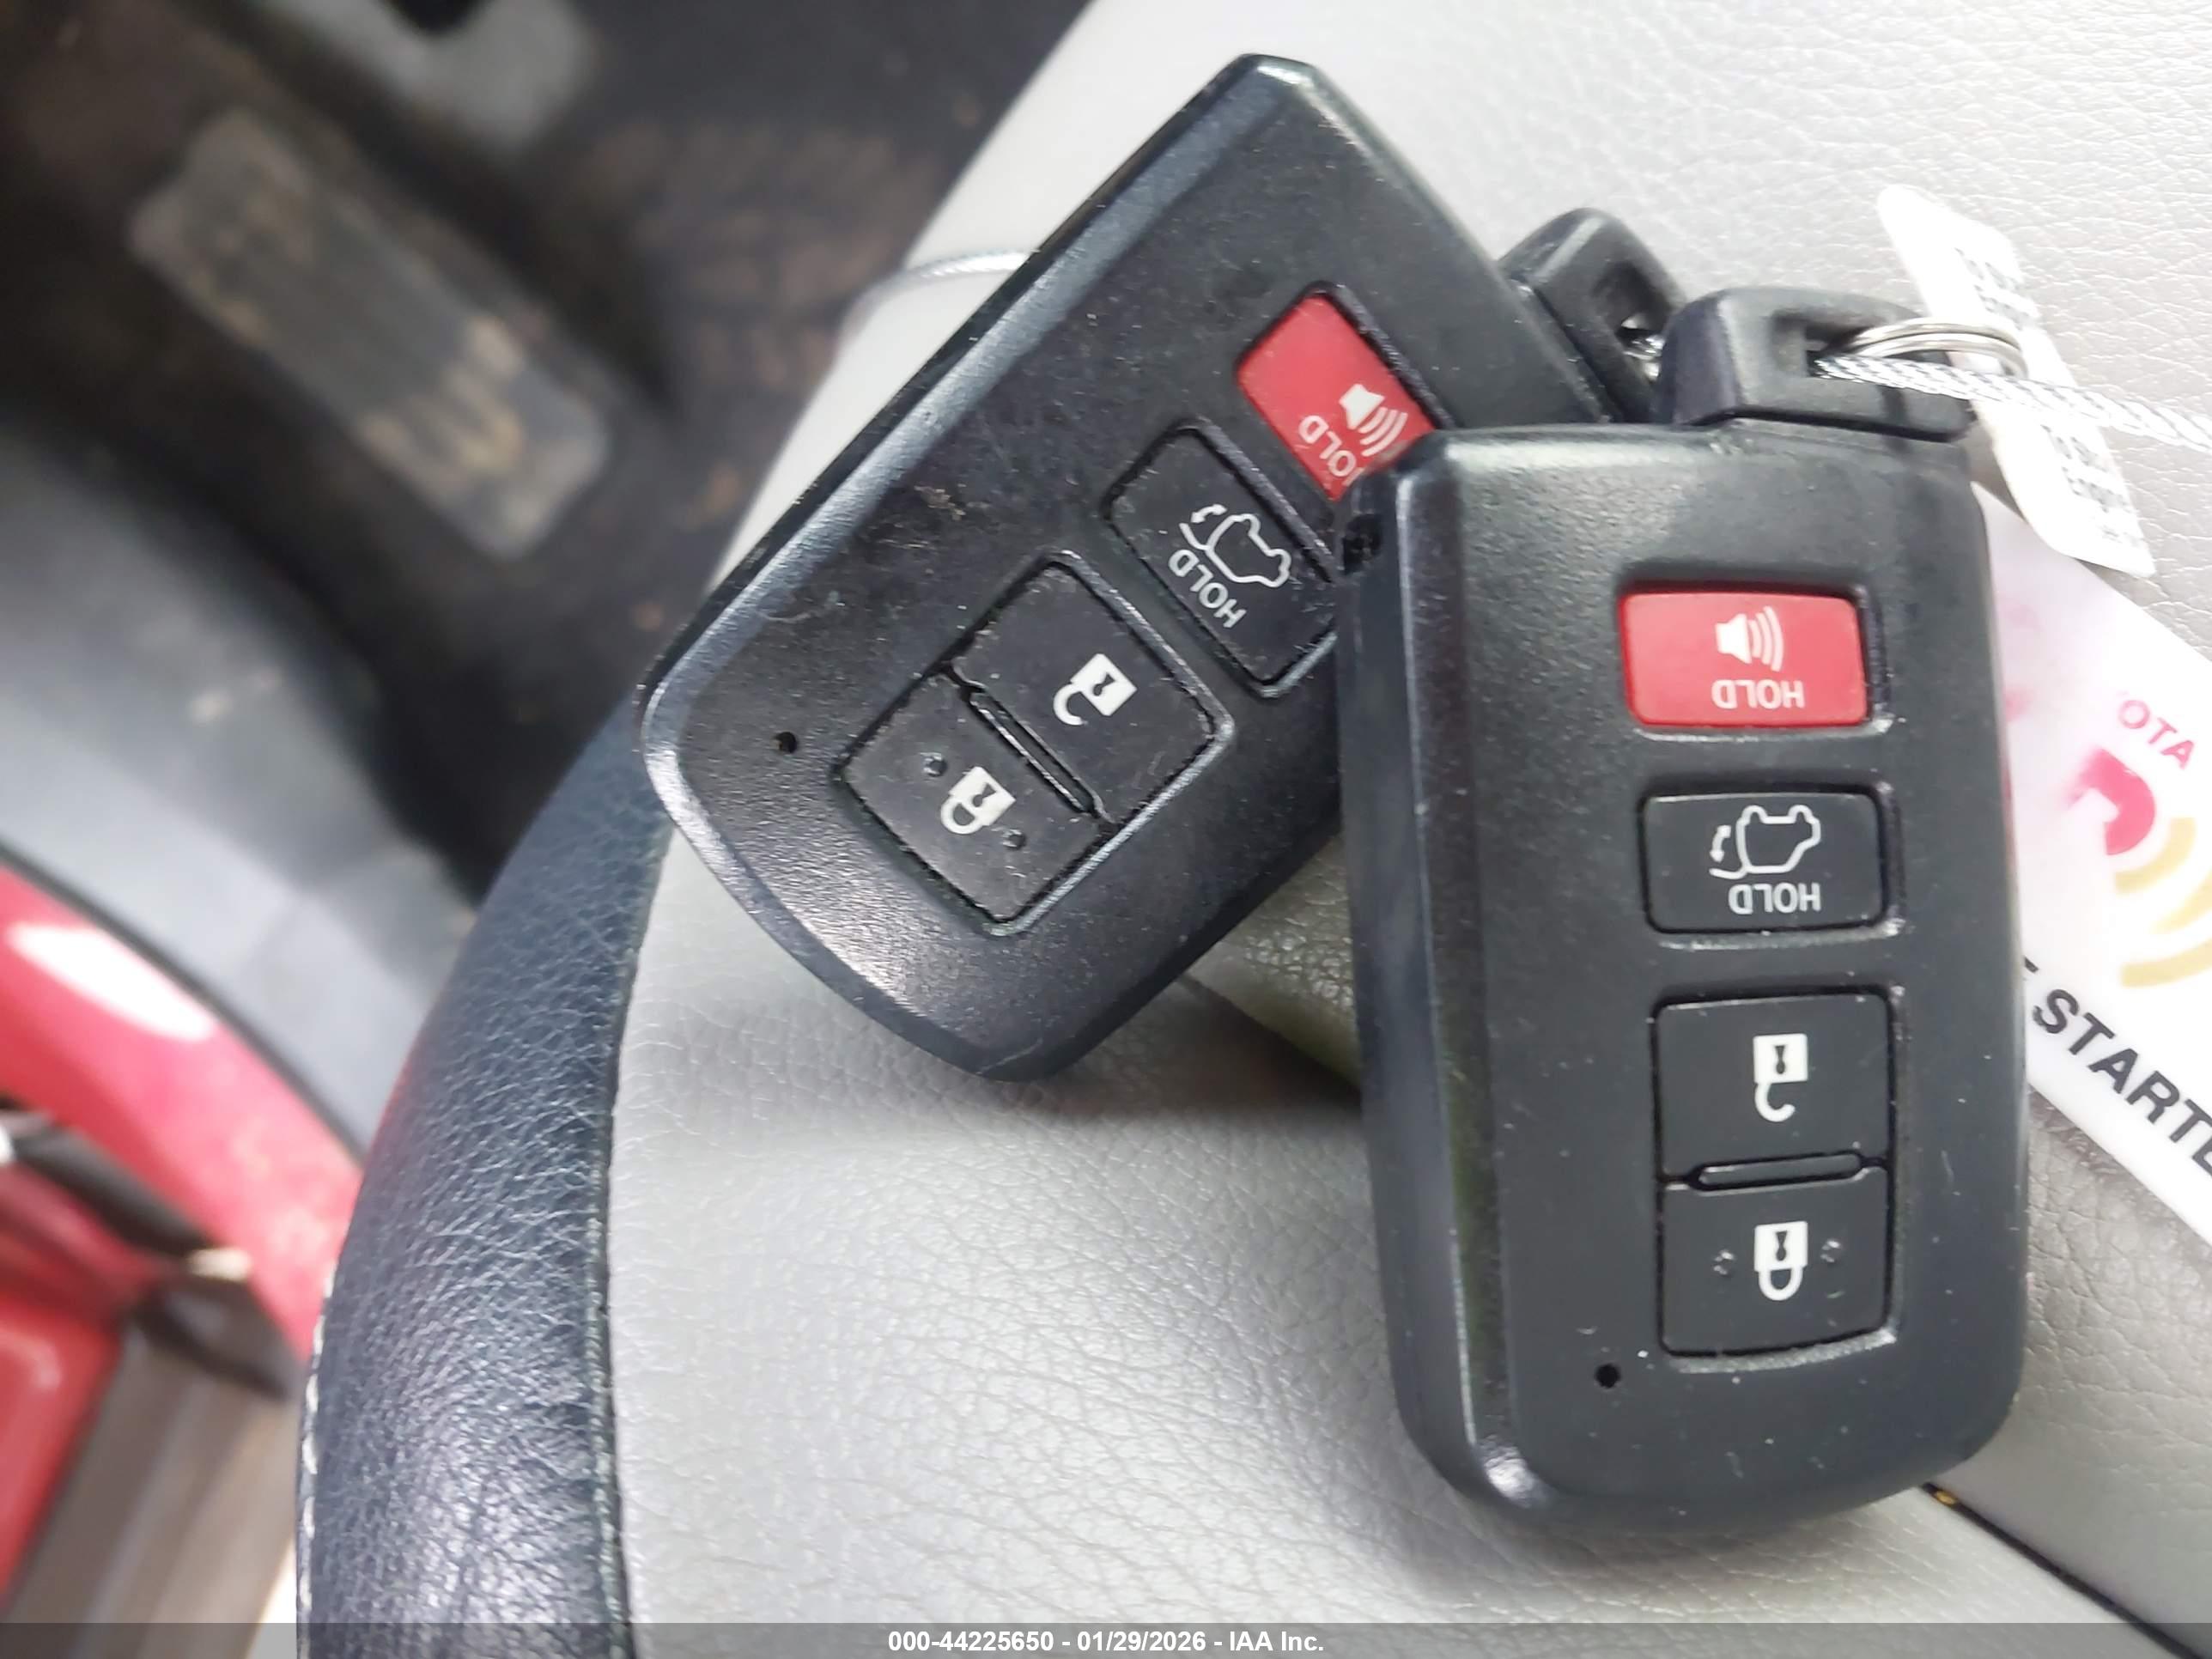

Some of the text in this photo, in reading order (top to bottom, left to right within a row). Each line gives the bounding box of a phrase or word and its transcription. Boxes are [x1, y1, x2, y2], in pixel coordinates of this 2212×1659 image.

[1168, 549, 1247, 628] HOLD
[1711, 679, 1806, 710] HOLD
[1728, 882, 1821, 915] HOLD
